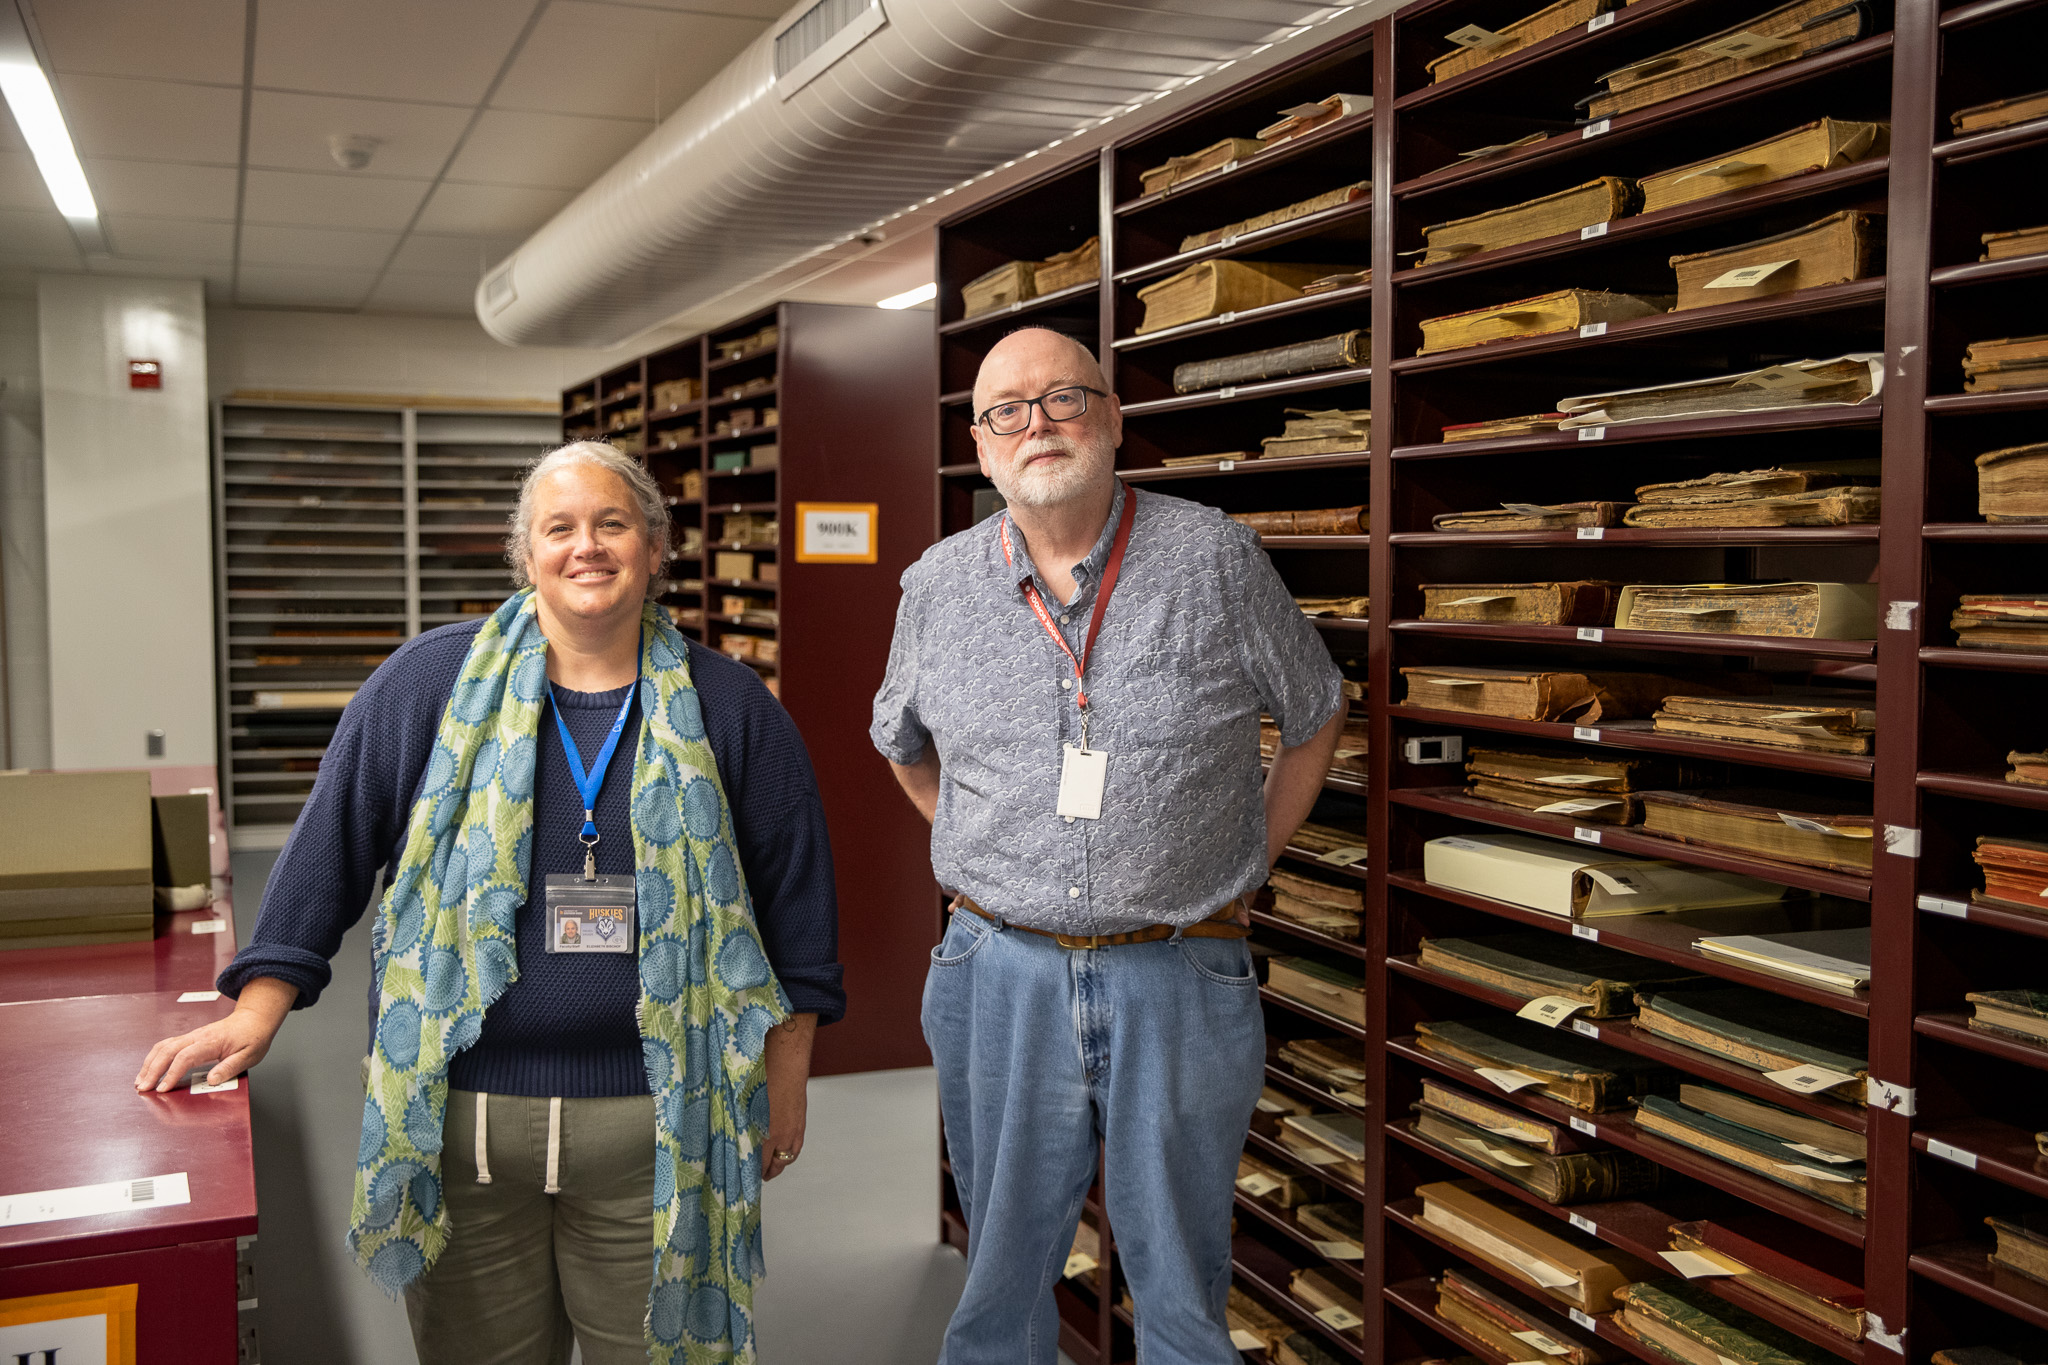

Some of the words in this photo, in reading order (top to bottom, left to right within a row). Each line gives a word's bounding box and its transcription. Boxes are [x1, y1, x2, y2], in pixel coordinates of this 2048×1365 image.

[1030, 592, 1047, 621] SCHOOL
[1045, 620, 1060, 641] BOOK
[589, 908, 624, 920] HUSKIES
